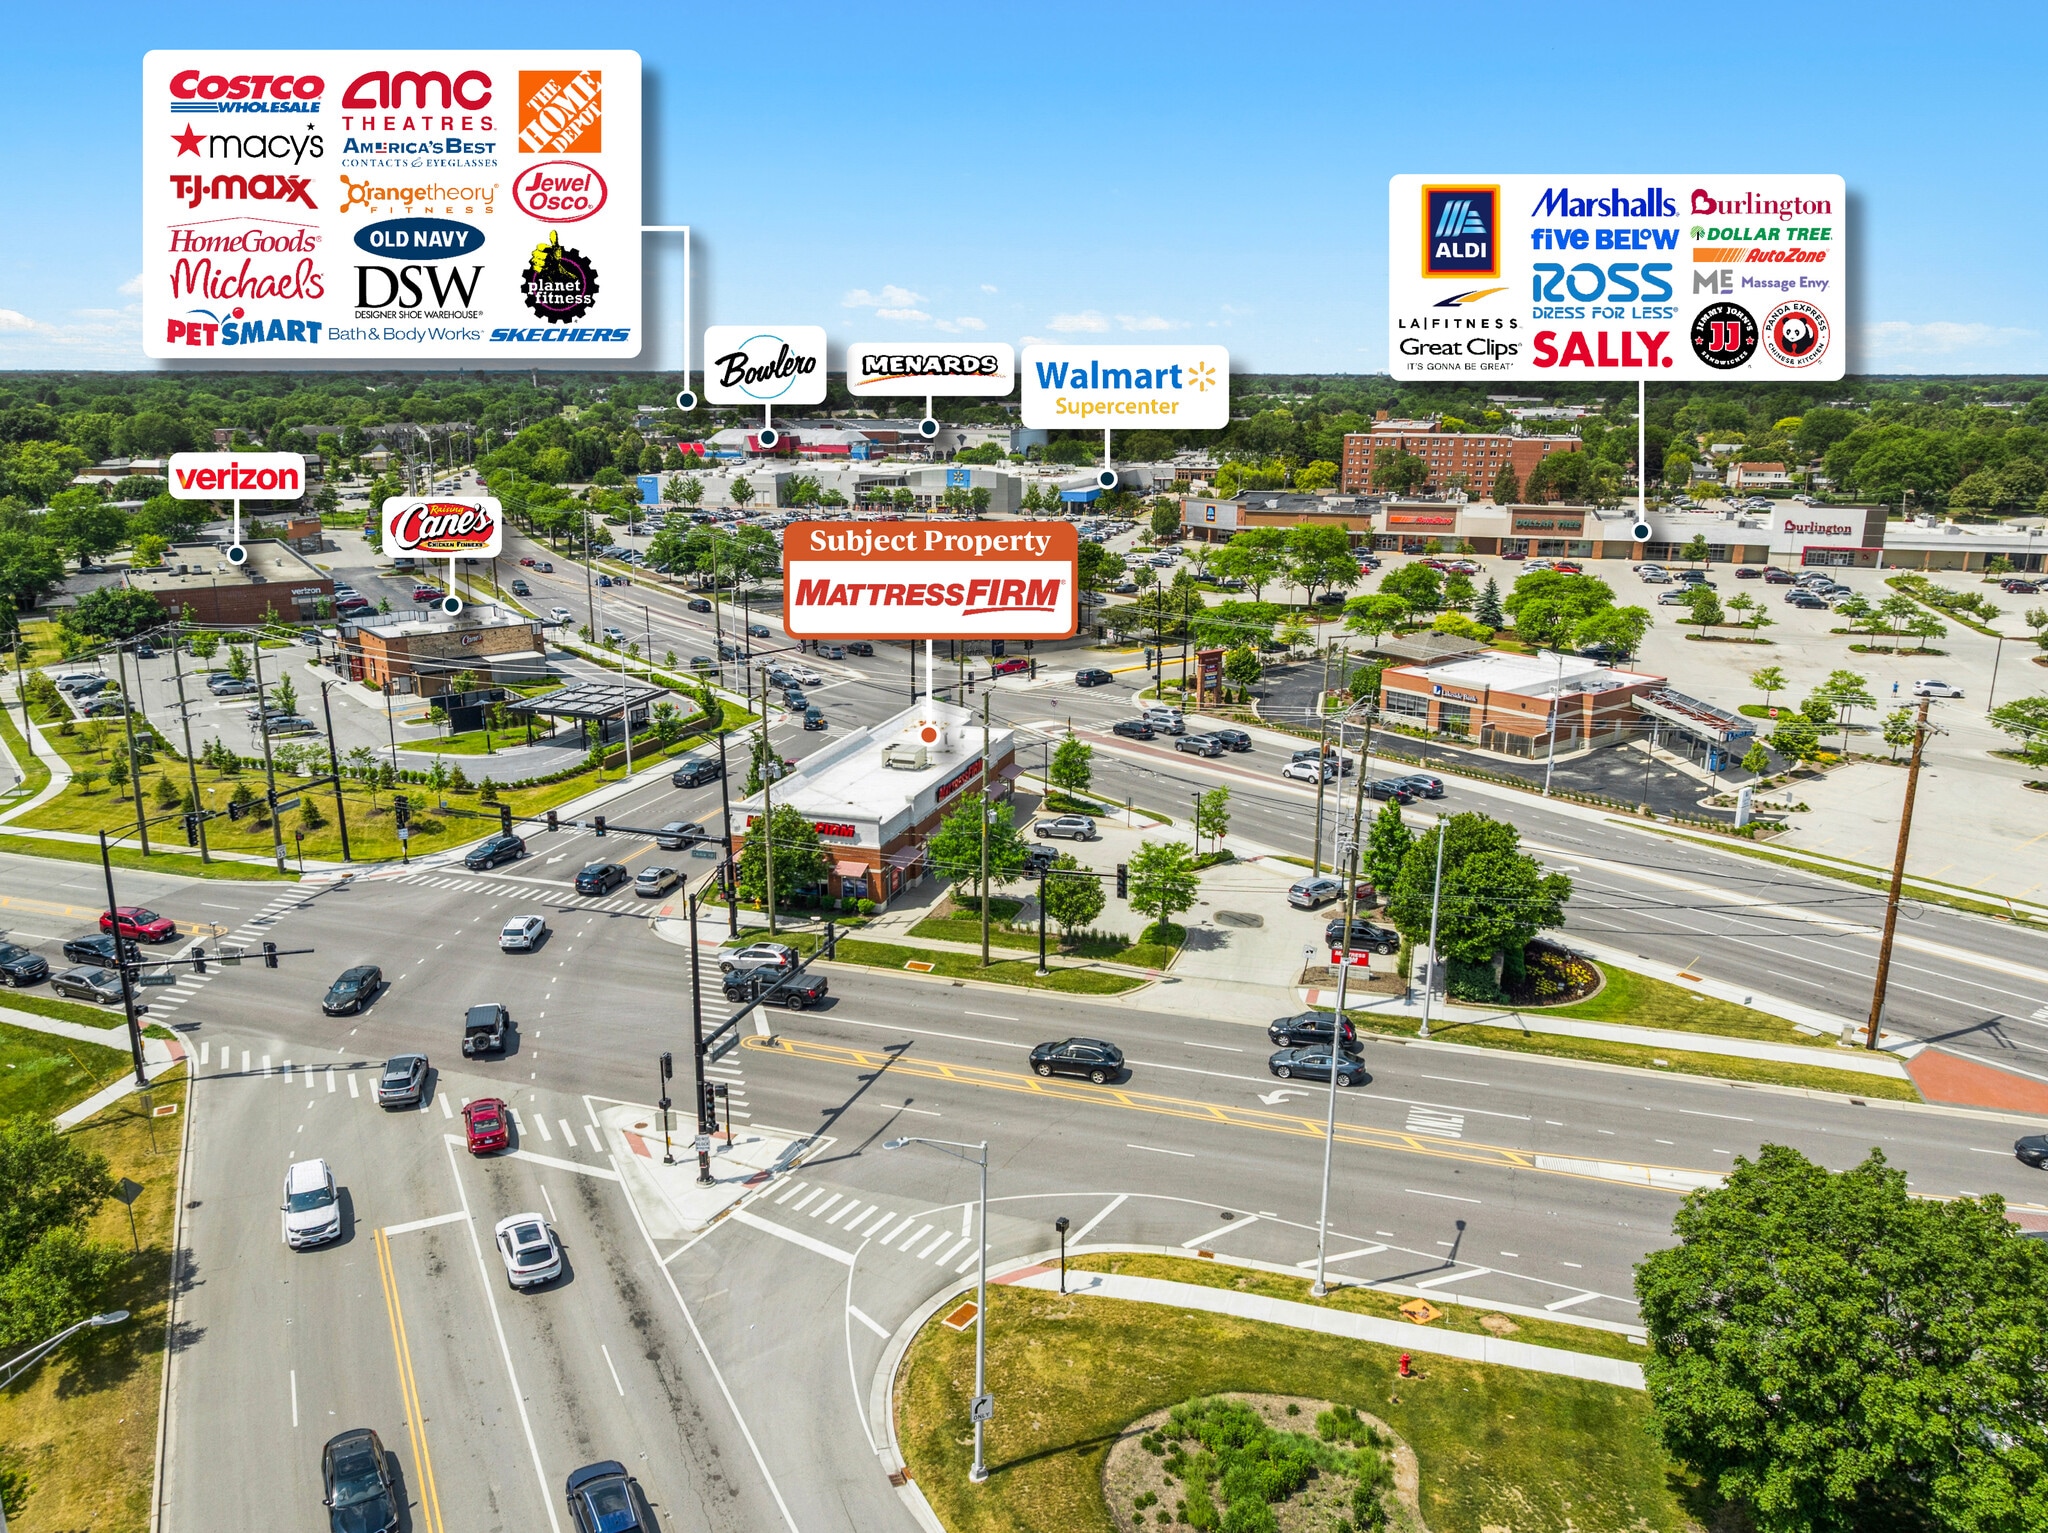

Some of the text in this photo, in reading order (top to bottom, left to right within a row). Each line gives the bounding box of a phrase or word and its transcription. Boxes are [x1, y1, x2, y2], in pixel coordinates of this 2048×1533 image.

[1516, 519, 1580, 528] DOLLAR TREE
[1784, 519, 1852, 536] Burlington
[291, 587, 321, 595] verizon
[974, 1412, 990, 1420] ONLY
